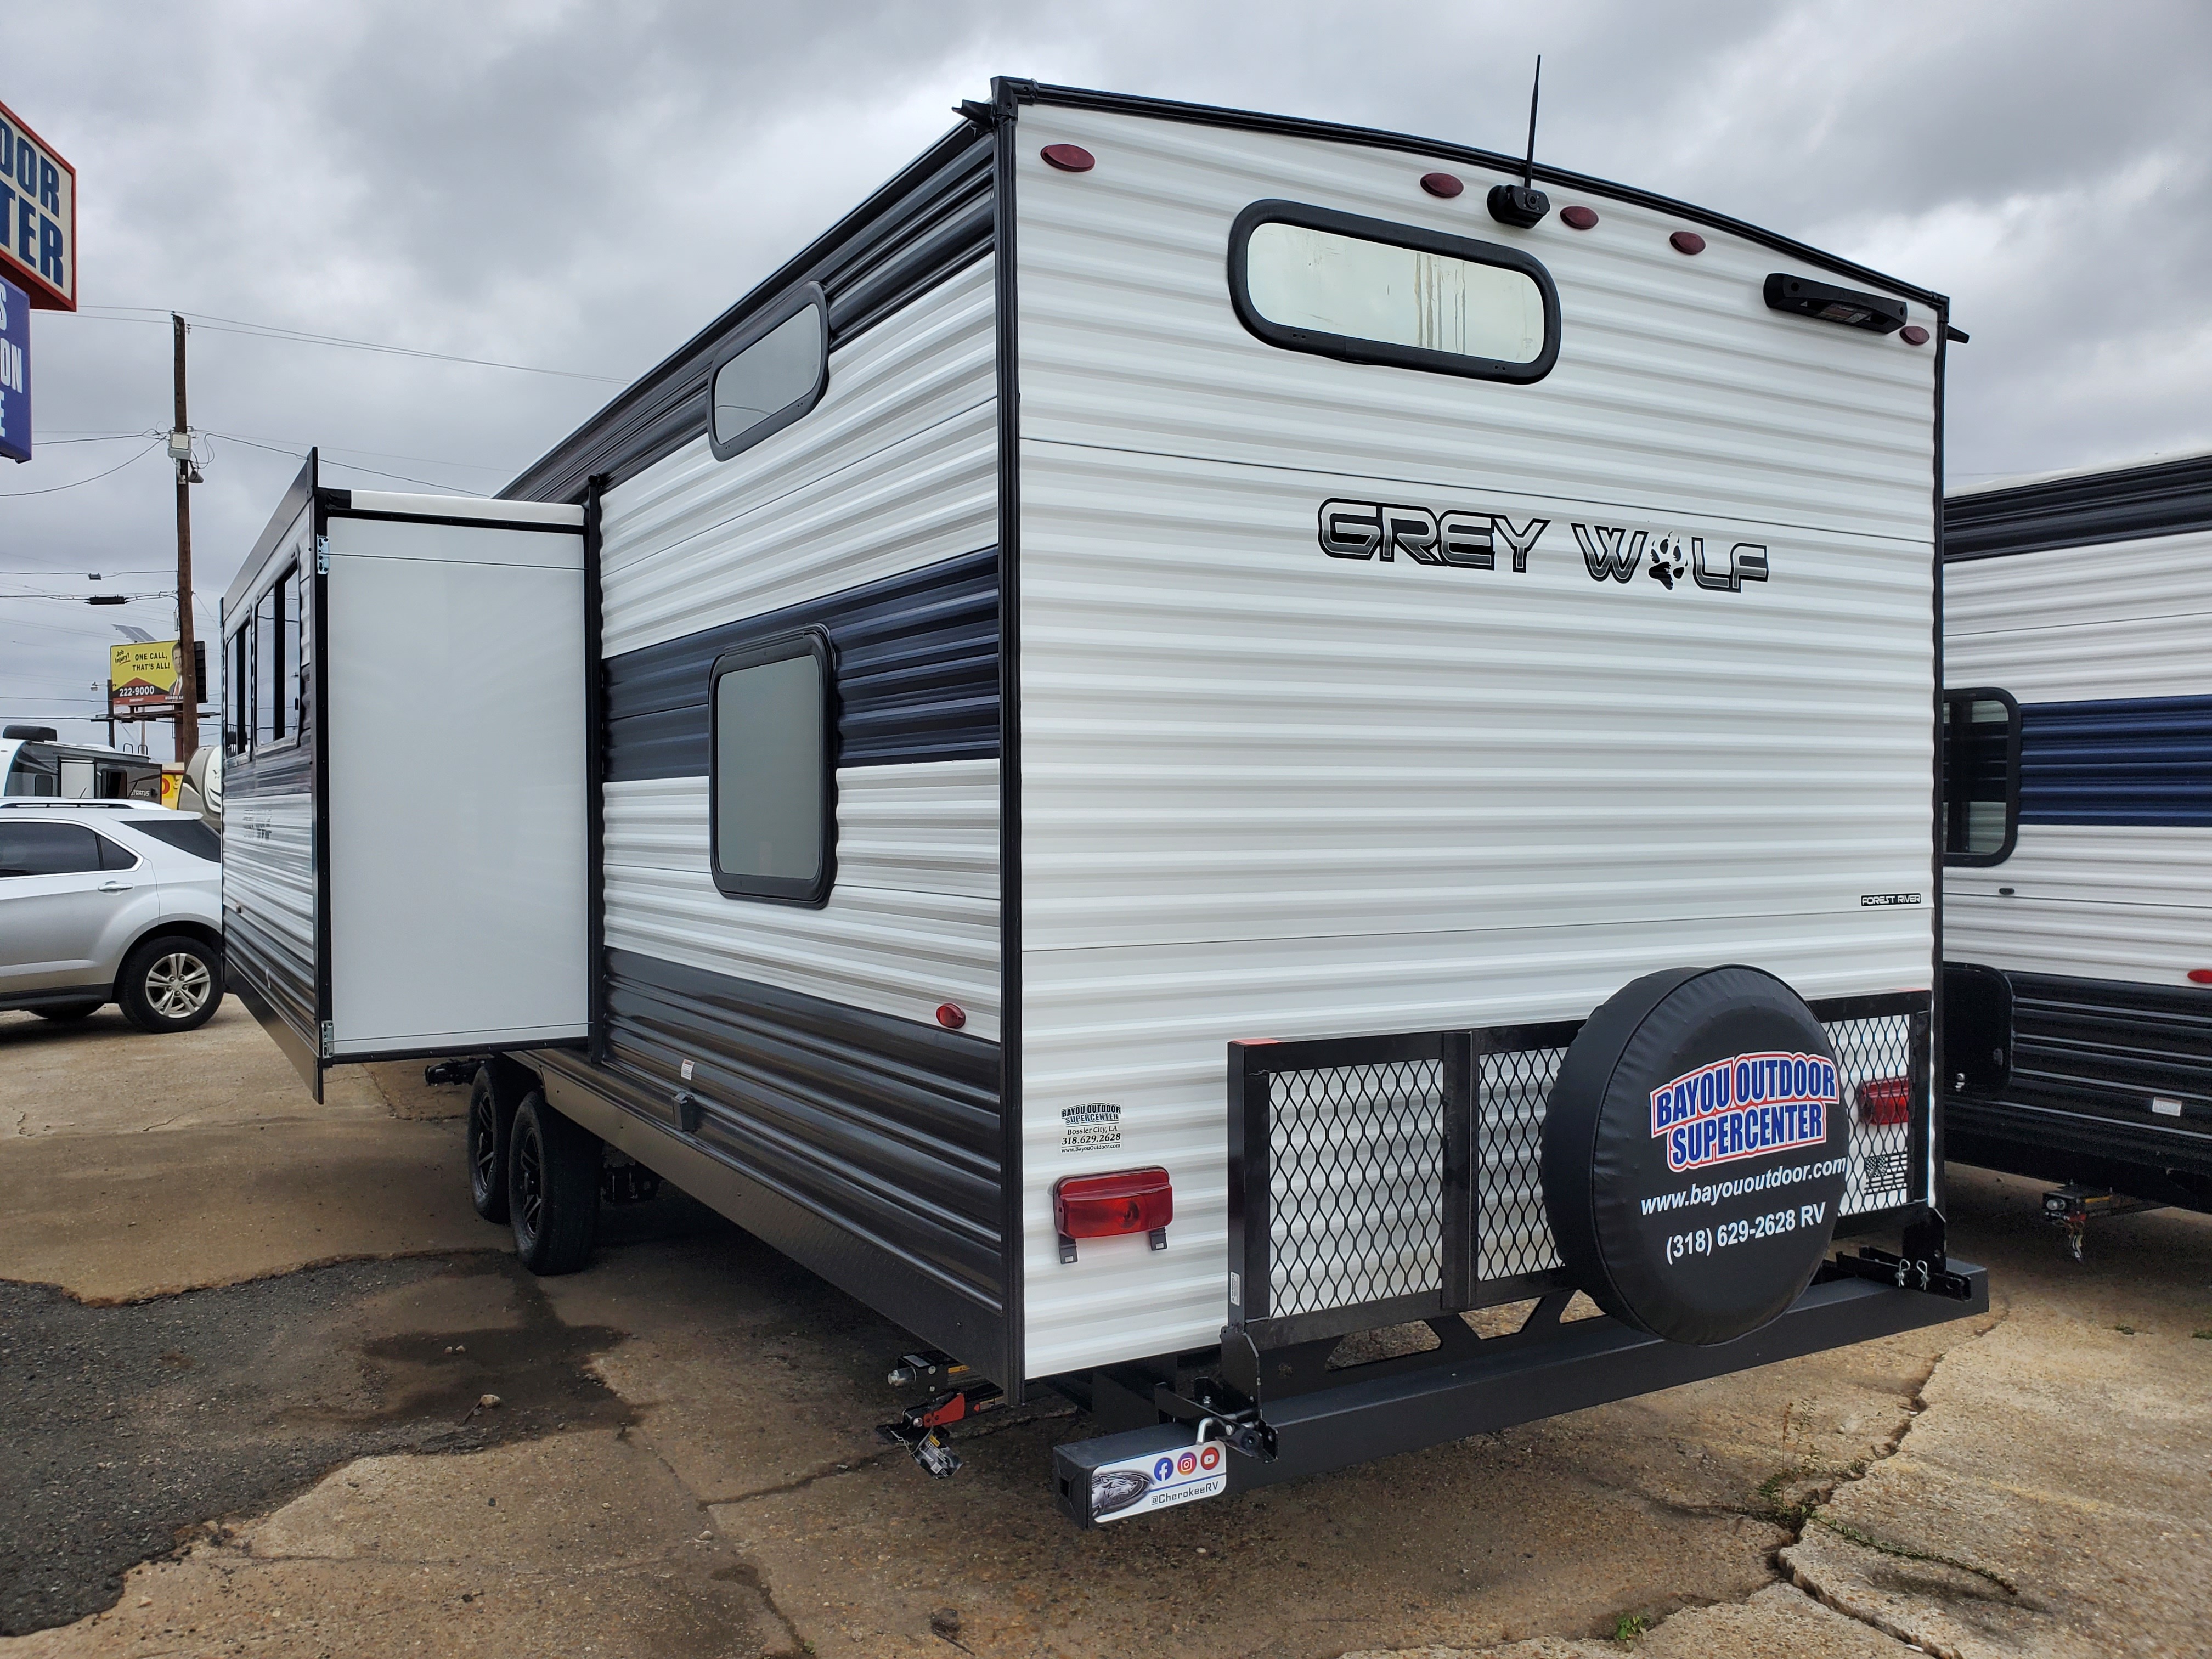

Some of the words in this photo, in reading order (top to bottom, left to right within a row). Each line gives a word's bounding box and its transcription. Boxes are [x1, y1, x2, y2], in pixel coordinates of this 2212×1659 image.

[1318, 498, 1551, 573] GREY
[115, 652, 130, 664] Injury?
[150, 652, 168, 660] CALL,
[132, 663, 154, 672] THAT'S
[119, 686, 155, 697] 222-9000
[1862, 895, 1895, 905] FOREST
[1898, 894, 1921, 904] RIVER
[1656, 1066, 1730, 1129] BAYOU
[1736, 1059, 1835, 1102] OUTDOOR
[1062, 1105, 1085, 1117] BAYOU
[1087, 1104, 1121, 1113] OUTDOOR
[1065, 1113, 1119, 1123] SUPERCENTER
[1093, 1126, 1108, 1134] City,
[1671, 1104, 1822, 1165] SUPERCENTER
[1062, 1133, 1121, 1145] 318.629.2628
[1061, 1144, 1121, 1153] www.BayouOutdoor.com
[1641, 1156, 1847, 1215] www.bayououtdoor.com
[1666, 1228, 1713, 1265] (318)
[1717, 1209, 1796, 1248] 629-2628
[1801, 1202, 1826, 1227] RV
[1152, 1481, 1219, 1505] @CherokeeRV
